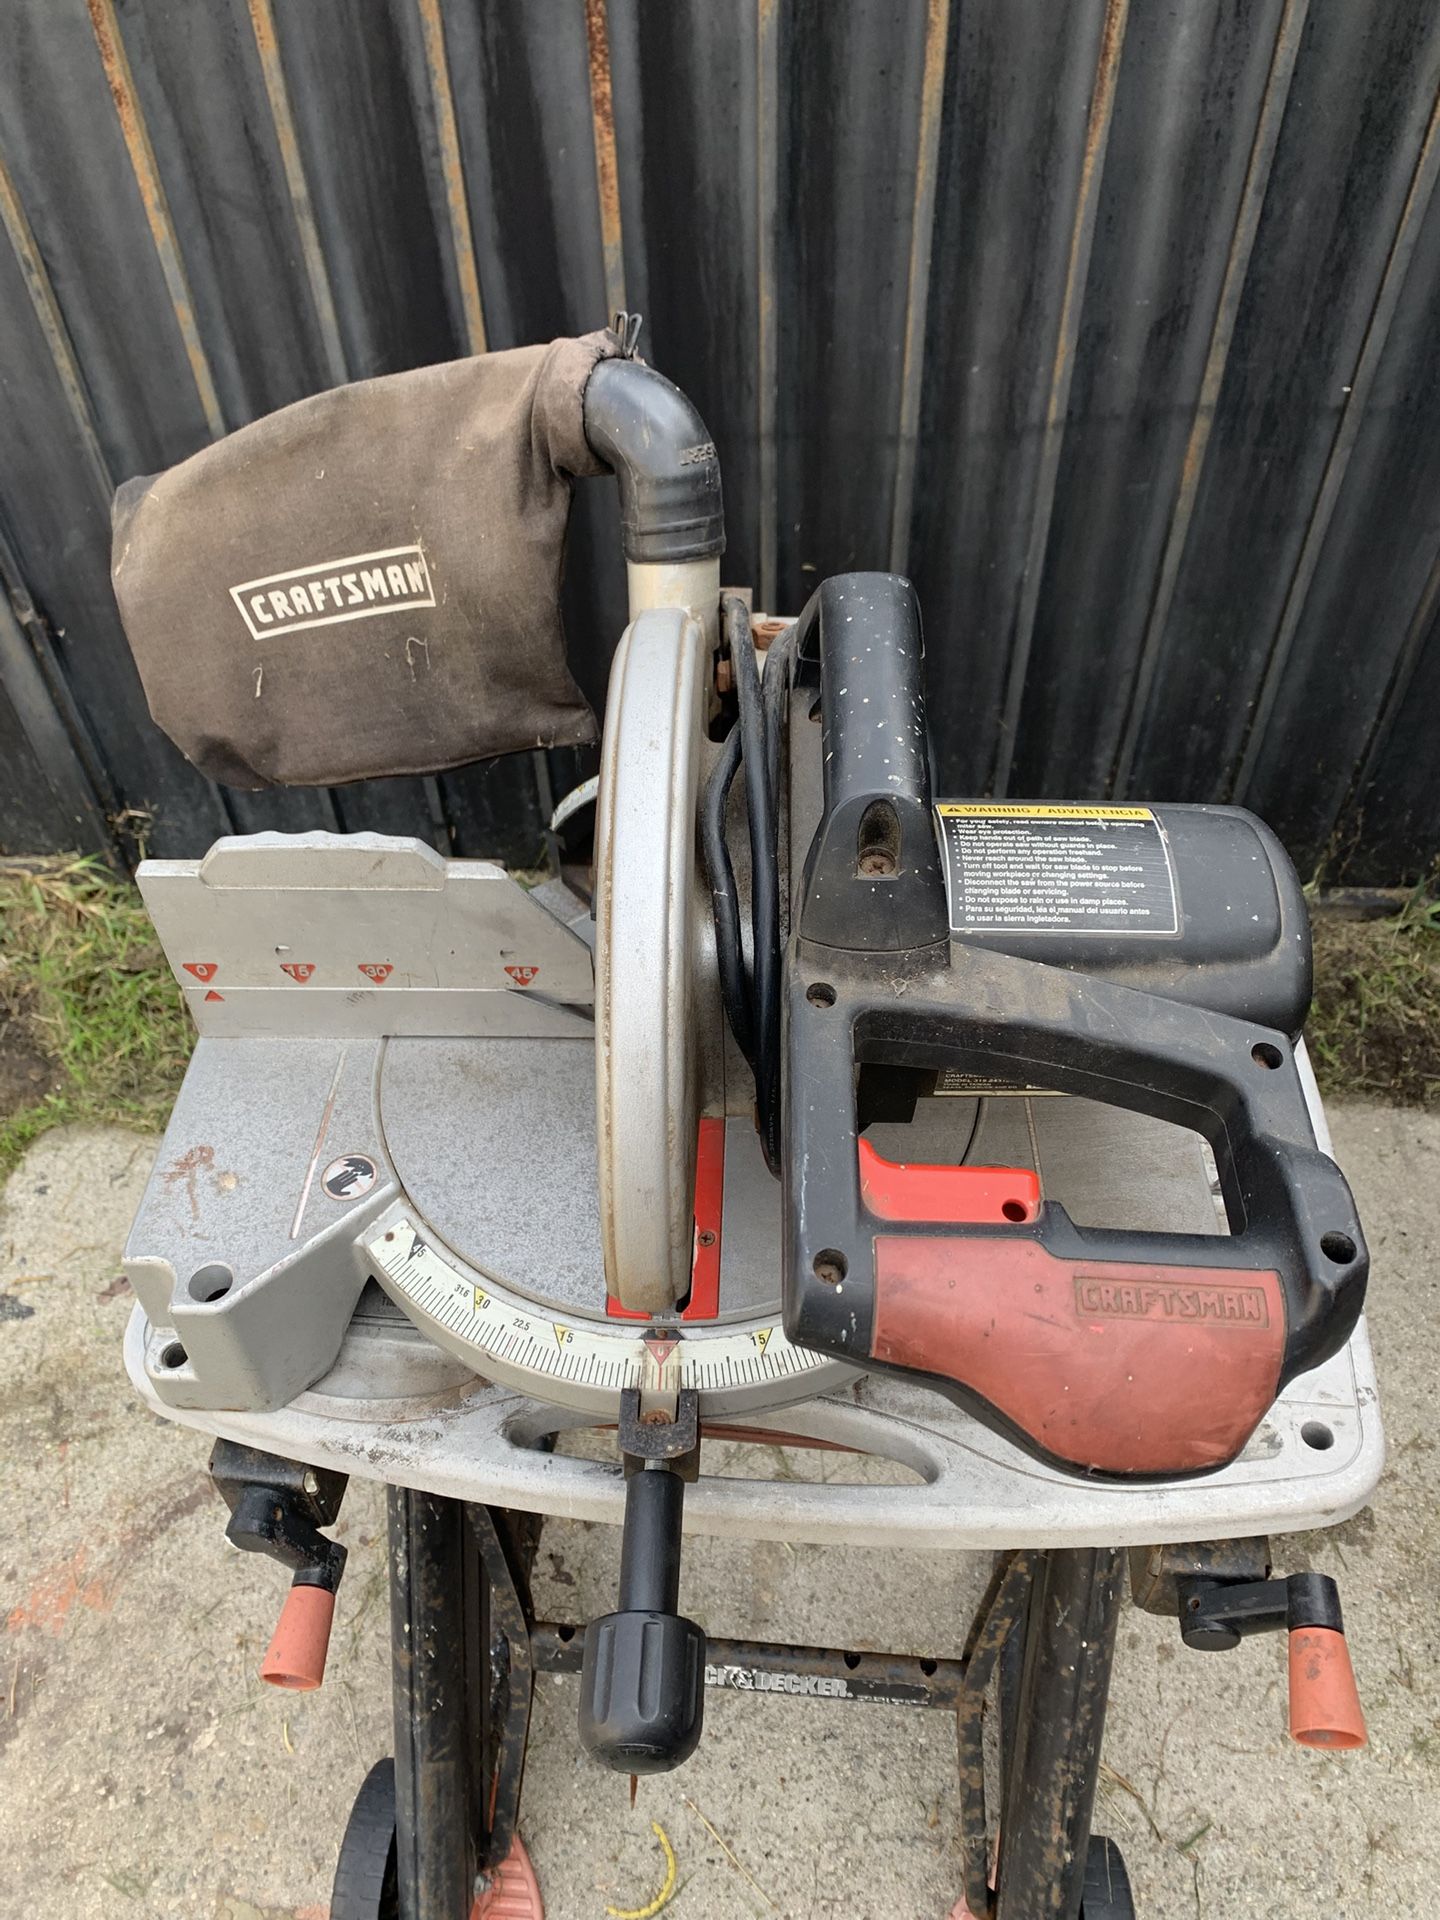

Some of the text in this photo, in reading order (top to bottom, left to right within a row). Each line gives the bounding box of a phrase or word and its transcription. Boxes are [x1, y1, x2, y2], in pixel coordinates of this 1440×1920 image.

[250, 561, 426, 623] CRAFTSMAN
[1048, 808, 1144, 816] ADVERTENCIA
[964, 870, 991, 878] moving
[964, 878, 1006, 886] Disconnect
[964, 888, 999, 896] changing
[1032, 888, 1069, 896] servicing.
[991, 897, 1018, 905] expose
[1079, 898, 1100, 906] damp
[1101, 898, 1129, 906] places.
[995, 906, 1035, 914] seguridad,
[1100, 907, 1128, 915] usuario
[195, 965, 208, 977] 0
[286, 965, 310, 977] 15
[365, 965, 388, 978] 30
[510, 967, 533, 980] 45
[411, 1243, 427, 1258] 45
[453, 1284, 471, 1298] 31.6
[475, 1295, 491, 1309] 30
[1080, 1283, 1262, 1321] CRAFTSMAN
[512, 1318, 531, 1331] 22.5
[559, 1330, 574, 1344] 15
[750, 1333, 767, 1347] 15
